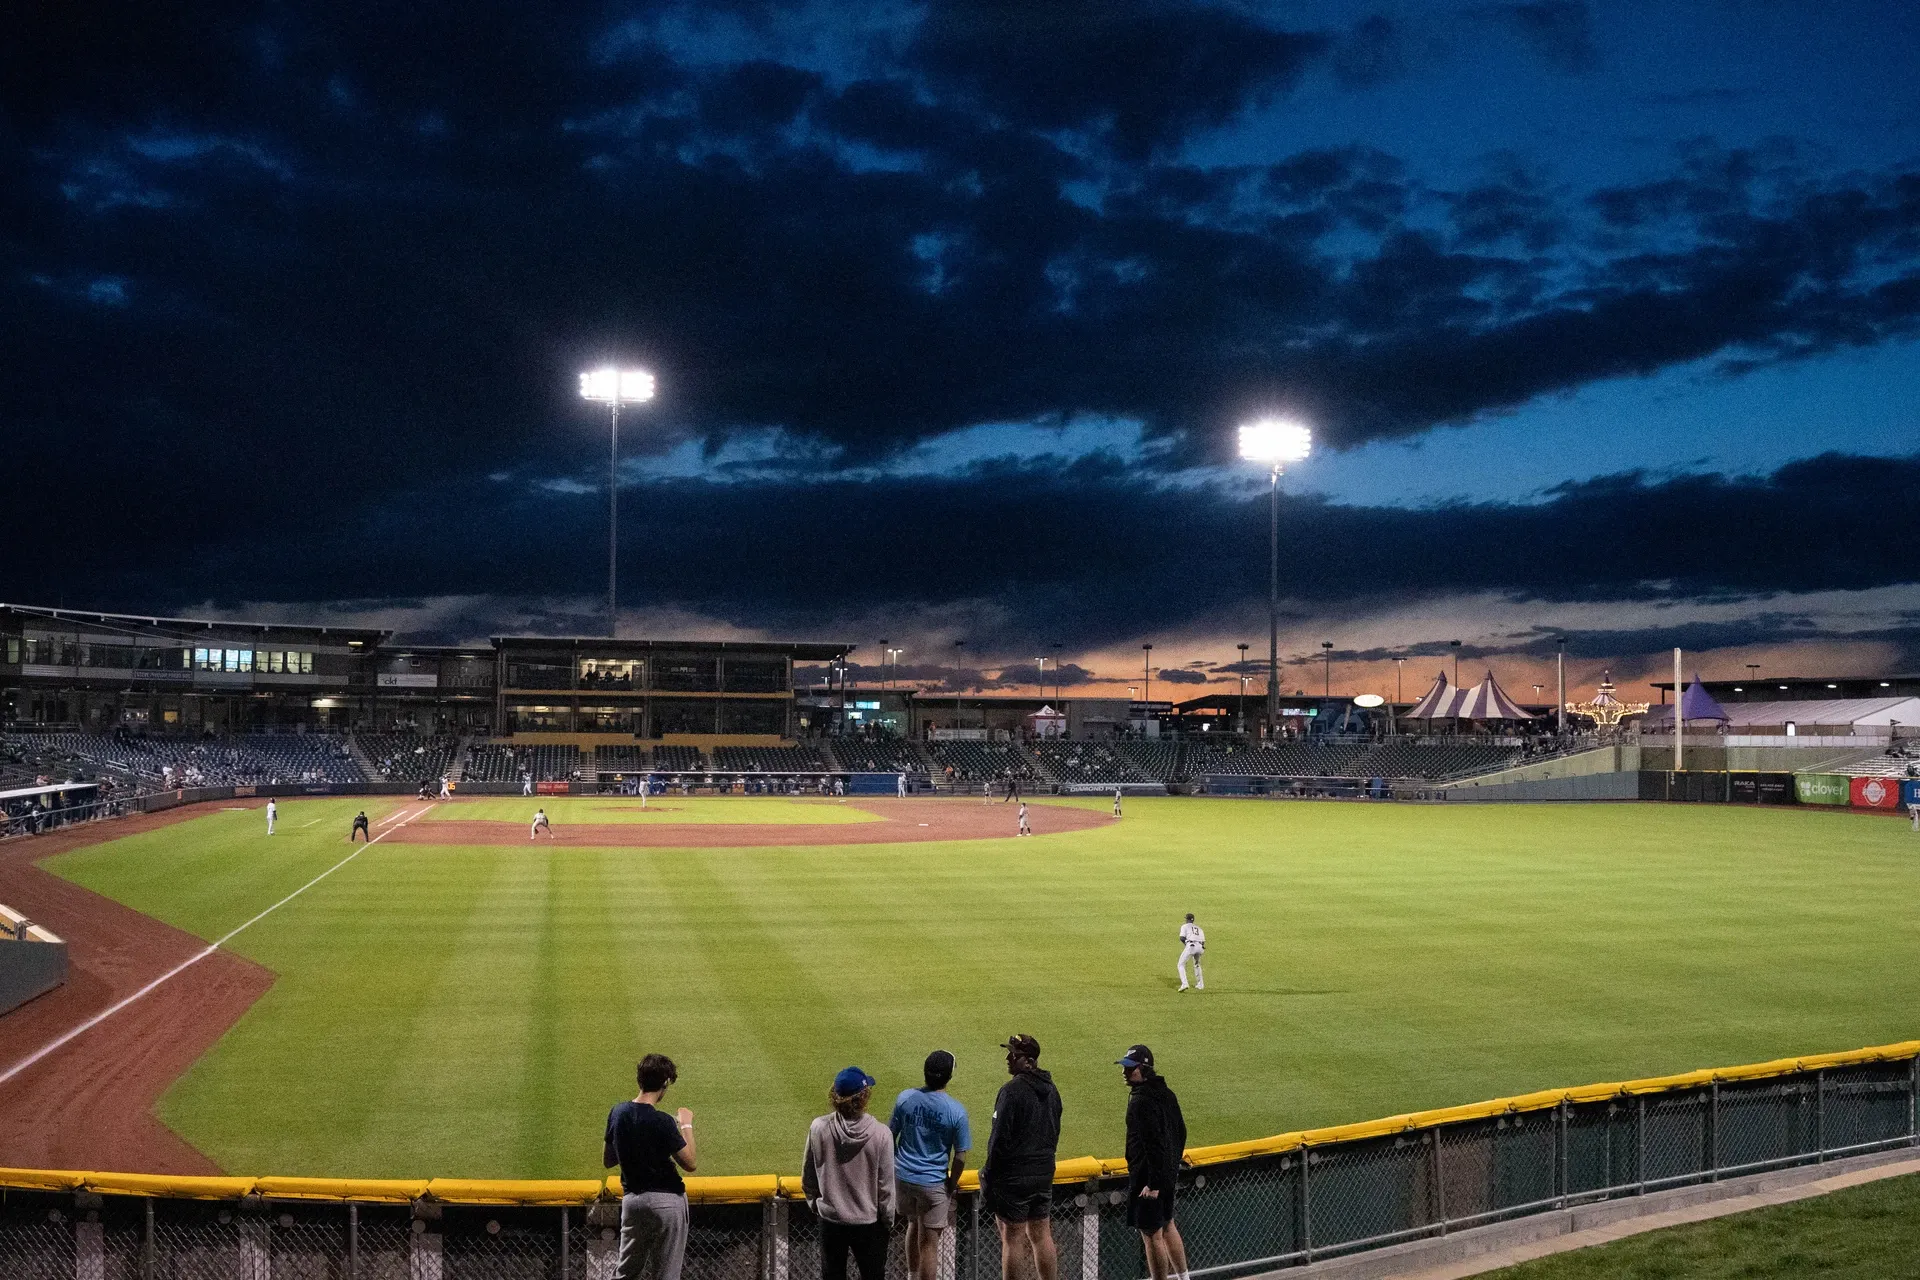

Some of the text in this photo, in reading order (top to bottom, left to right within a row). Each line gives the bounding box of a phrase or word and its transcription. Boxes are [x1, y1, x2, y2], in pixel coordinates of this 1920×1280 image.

[1070, 785, 1105, 793] DIAMOND
[1811, 782, 1844, 796] clover
[1191, 926, 1200, 936] 13
